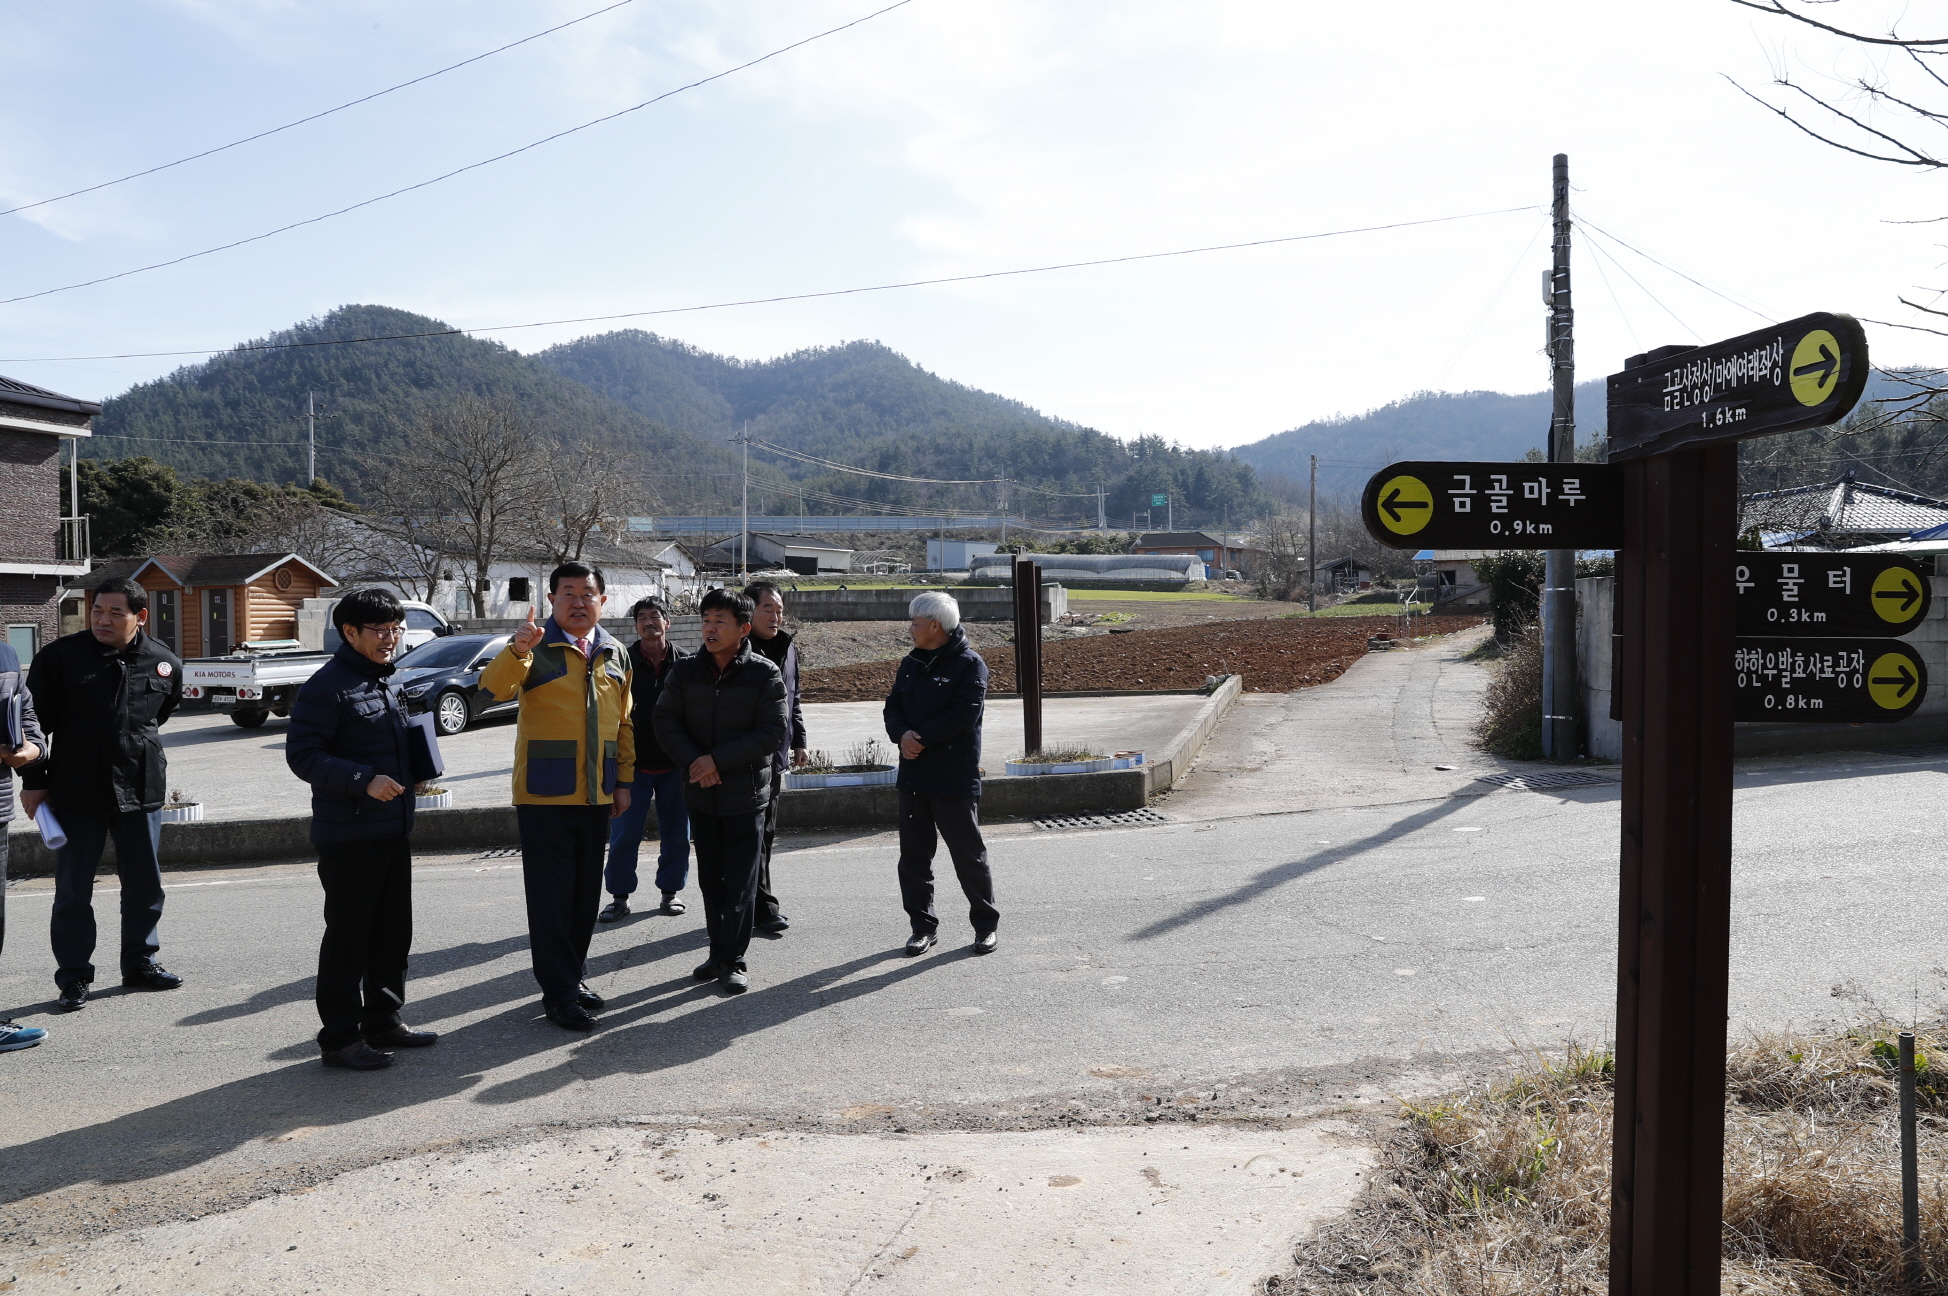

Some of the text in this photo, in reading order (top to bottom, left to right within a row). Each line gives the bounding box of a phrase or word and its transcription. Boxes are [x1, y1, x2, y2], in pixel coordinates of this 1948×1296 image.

[1662, 336, 1784, 411] 금골산정상/마애여래좌상
[1702, 406, 1746, 428] 1.6km
[1447, 475, 1586, 512] 금골마루
[1490, 520, 1552, 535] 0.9km
[1767, 608, 1826, 623] 0.3km
[207, 671, 236, 679] MOTORS
[1764, 694, 1823, 709] 0.8km
